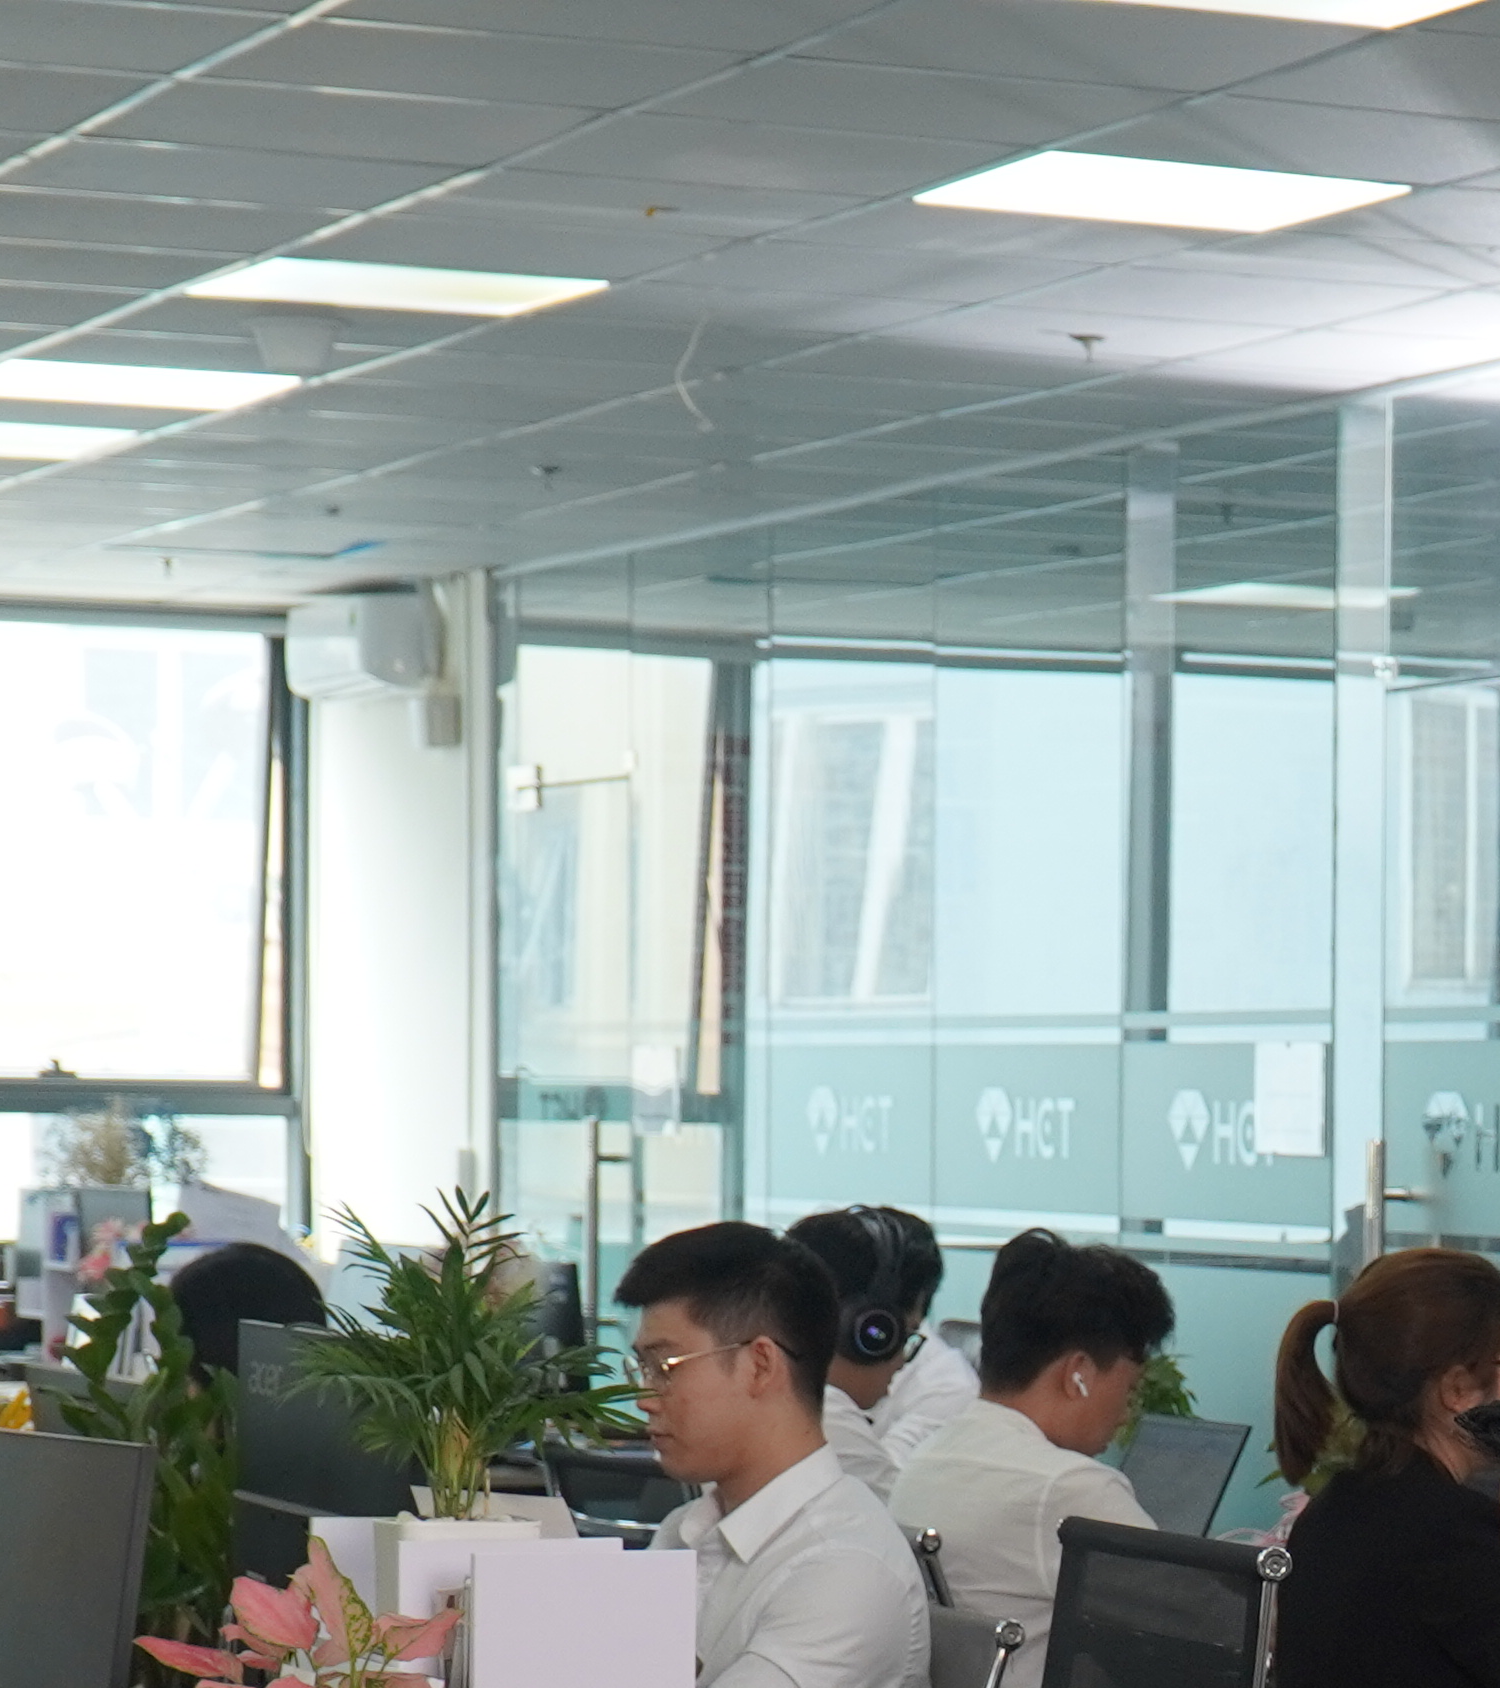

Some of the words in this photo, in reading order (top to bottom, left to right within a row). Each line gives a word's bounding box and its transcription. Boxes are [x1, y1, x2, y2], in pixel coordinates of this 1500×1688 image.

[840, 1095, 893, 1152] HCT
[1015, 1097, 1076, 1160] HCT
[1213, 1100, 1274, 1167] HC
